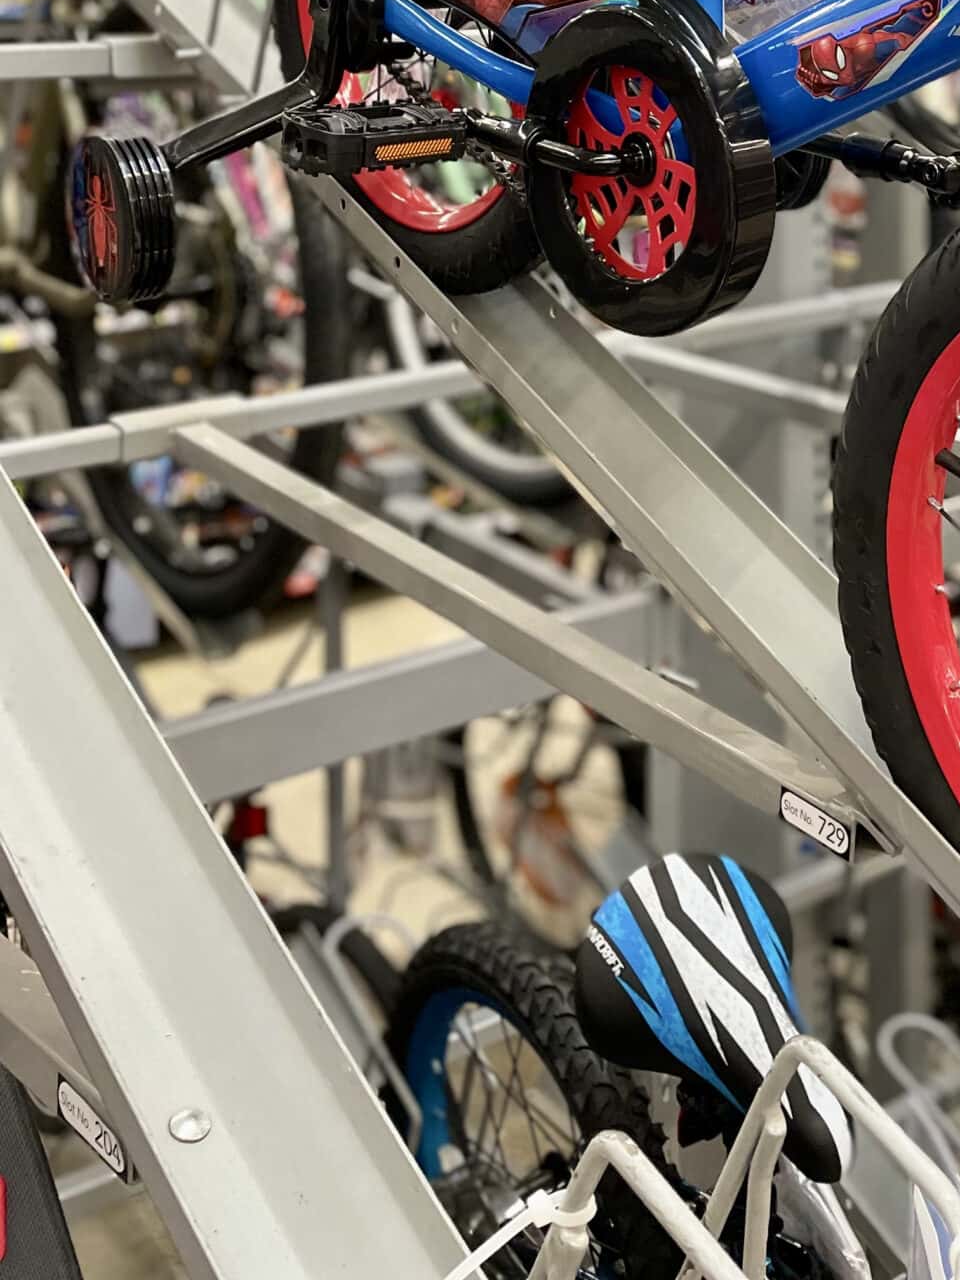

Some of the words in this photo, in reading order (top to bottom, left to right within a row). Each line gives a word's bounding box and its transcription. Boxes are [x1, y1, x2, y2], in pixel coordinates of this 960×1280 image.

[784, 799, 799, 817] Slot
[817, 814, 846, 848] 729
[95, 1120, 121, 1166] 204
